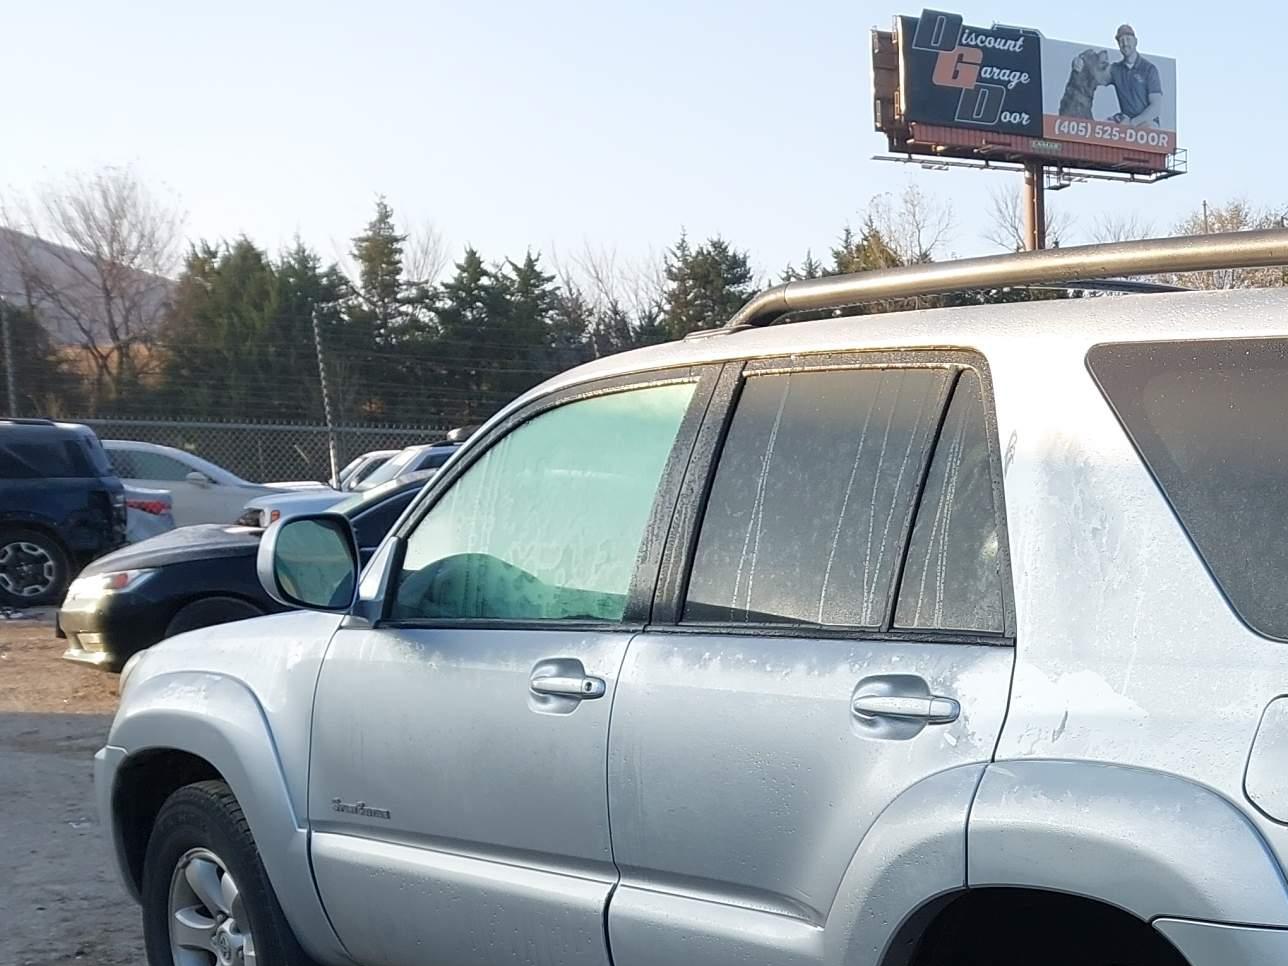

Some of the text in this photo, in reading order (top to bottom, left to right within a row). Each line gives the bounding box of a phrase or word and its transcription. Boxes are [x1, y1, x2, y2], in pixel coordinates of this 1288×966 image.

[912, 8, 1024, 52] Discount
[932, 46, 1031, 90] Garage
[955, 82, 1031, 126] Door
[1054, 119, 1169, 148] (405) 525-DOOR
